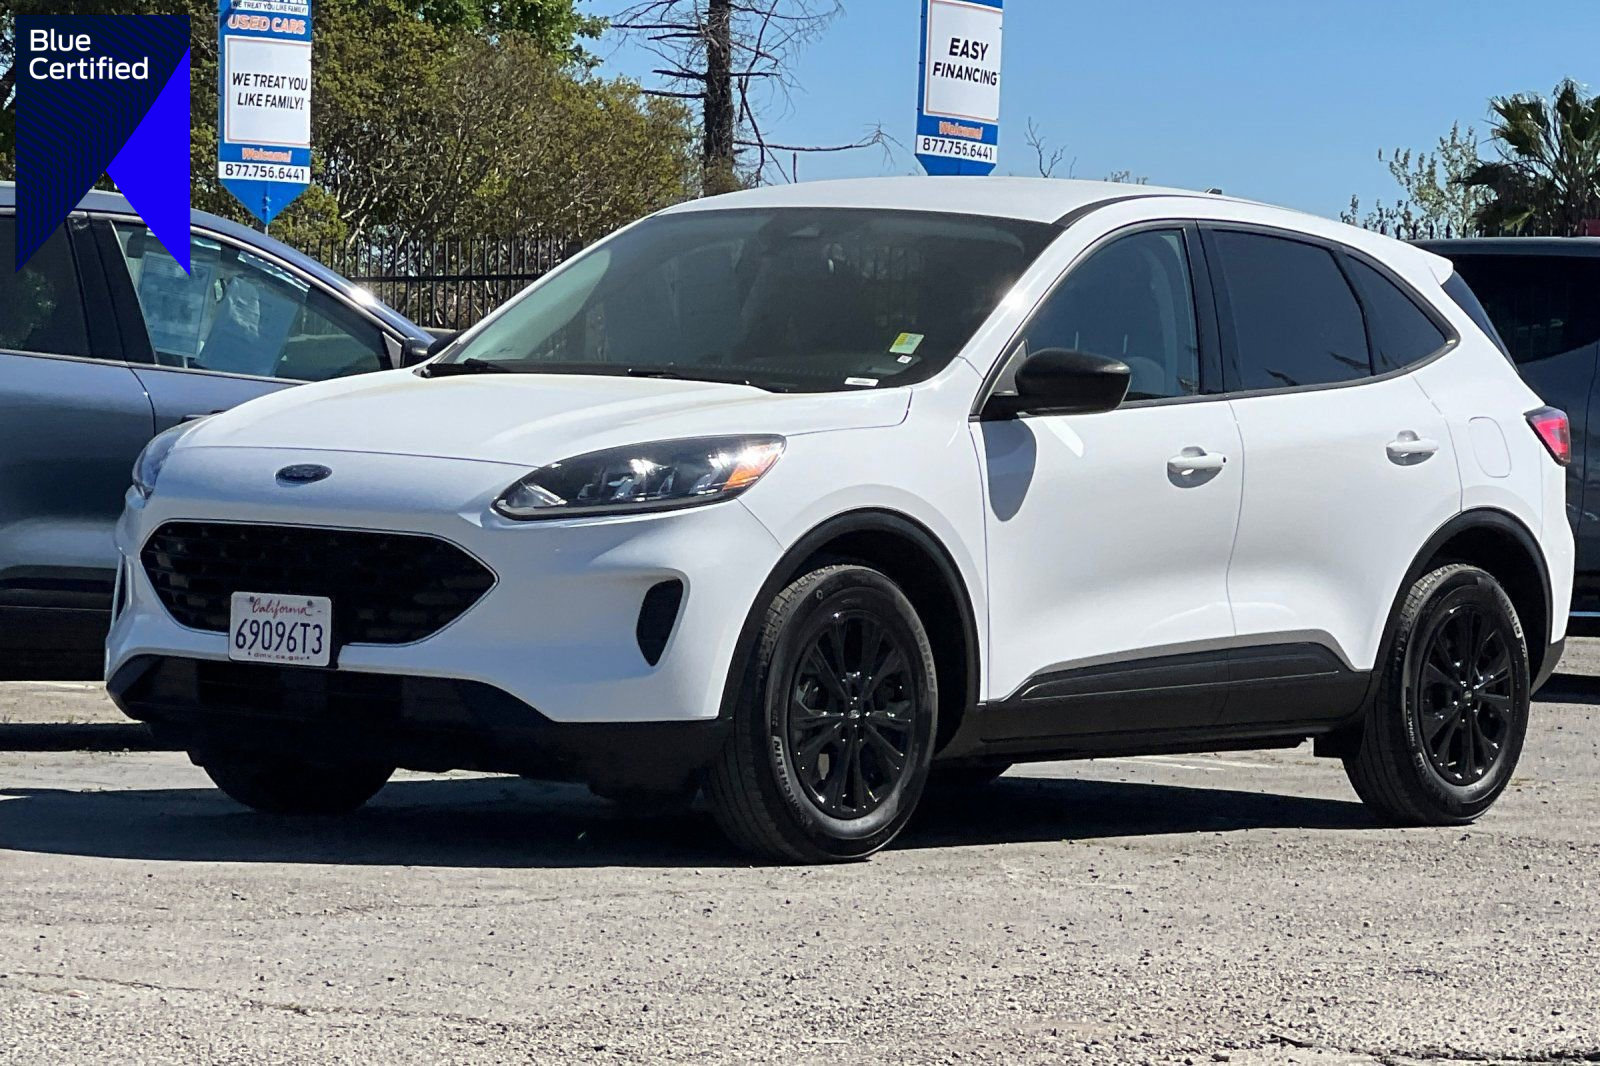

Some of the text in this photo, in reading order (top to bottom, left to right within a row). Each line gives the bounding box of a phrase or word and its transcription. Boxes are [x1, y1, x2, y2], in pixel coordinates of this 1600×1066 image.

[228, 14, 306, 35] USED CARS
[949, 38, 989, 61] EASY
[232, 72, 308, 91] WE TREAT YOU
[932, 62, 997, 86] FINANCING
[237, 92, 304, 110] LIKE FAMILY!
[923, 138, 992, 160] 877.756.6441
[225, 164, 304, 181] 877.756.6441
[252, 598, 313, 619] California
[236, 619, 323, 654] 69096T3
